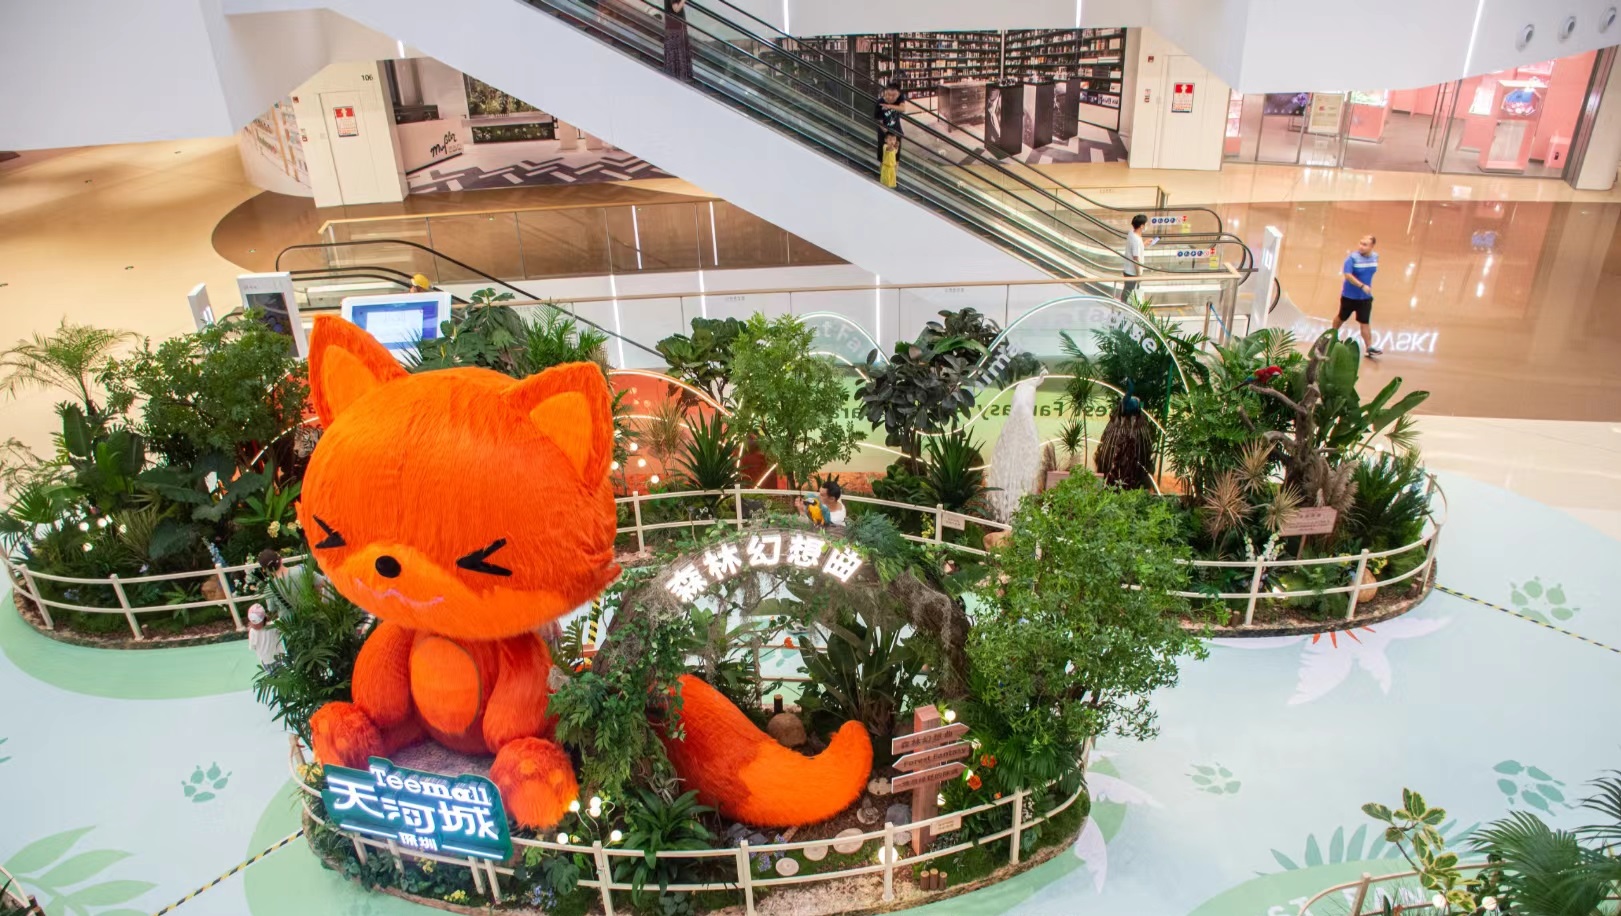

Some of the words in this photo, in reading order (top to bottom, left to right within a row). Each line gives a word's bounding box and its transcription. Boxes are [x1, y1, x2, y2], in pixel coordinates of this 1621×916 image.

[665, 533, 863, 603] 森林幻想曲
[903, 756, 931, 767] Forest
[933, 749, 966, 760] Fantasy
[369, 767, 493, 806] Teemall
[327, 776, 499, 840] 天河城
[398, 832, 438, 851] 深圳
